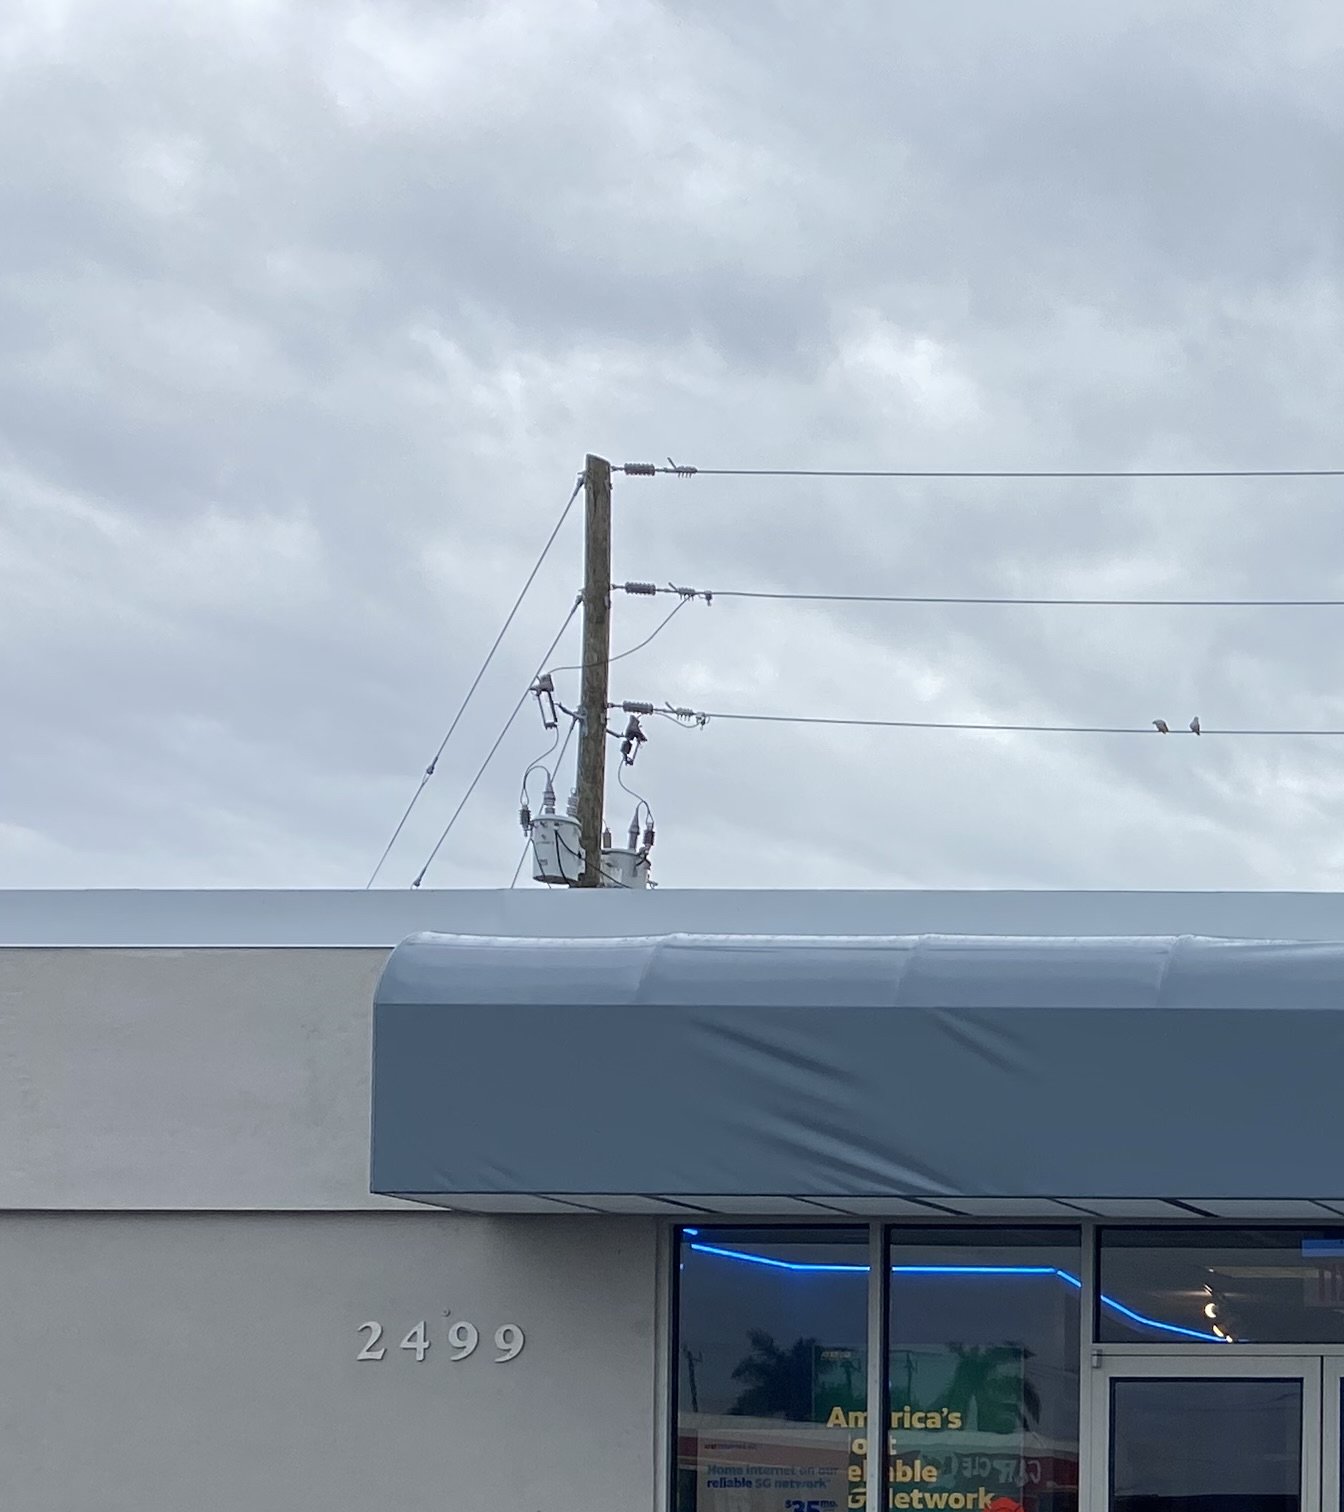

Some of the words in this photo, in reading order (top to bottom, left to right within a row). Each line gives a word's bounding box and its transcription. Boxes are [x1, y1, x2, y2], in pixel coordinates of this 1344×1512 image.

[356, 1320, 526, 1364] 2499
[826, 1405, 962, 1429] Amrica's
[707, 1464, 743, 1475] Home
[746, 1464, 795, 1475] internet
[707, 1477, 753, 1488] reliable
[889, 1486, 996, 1510] etwork
